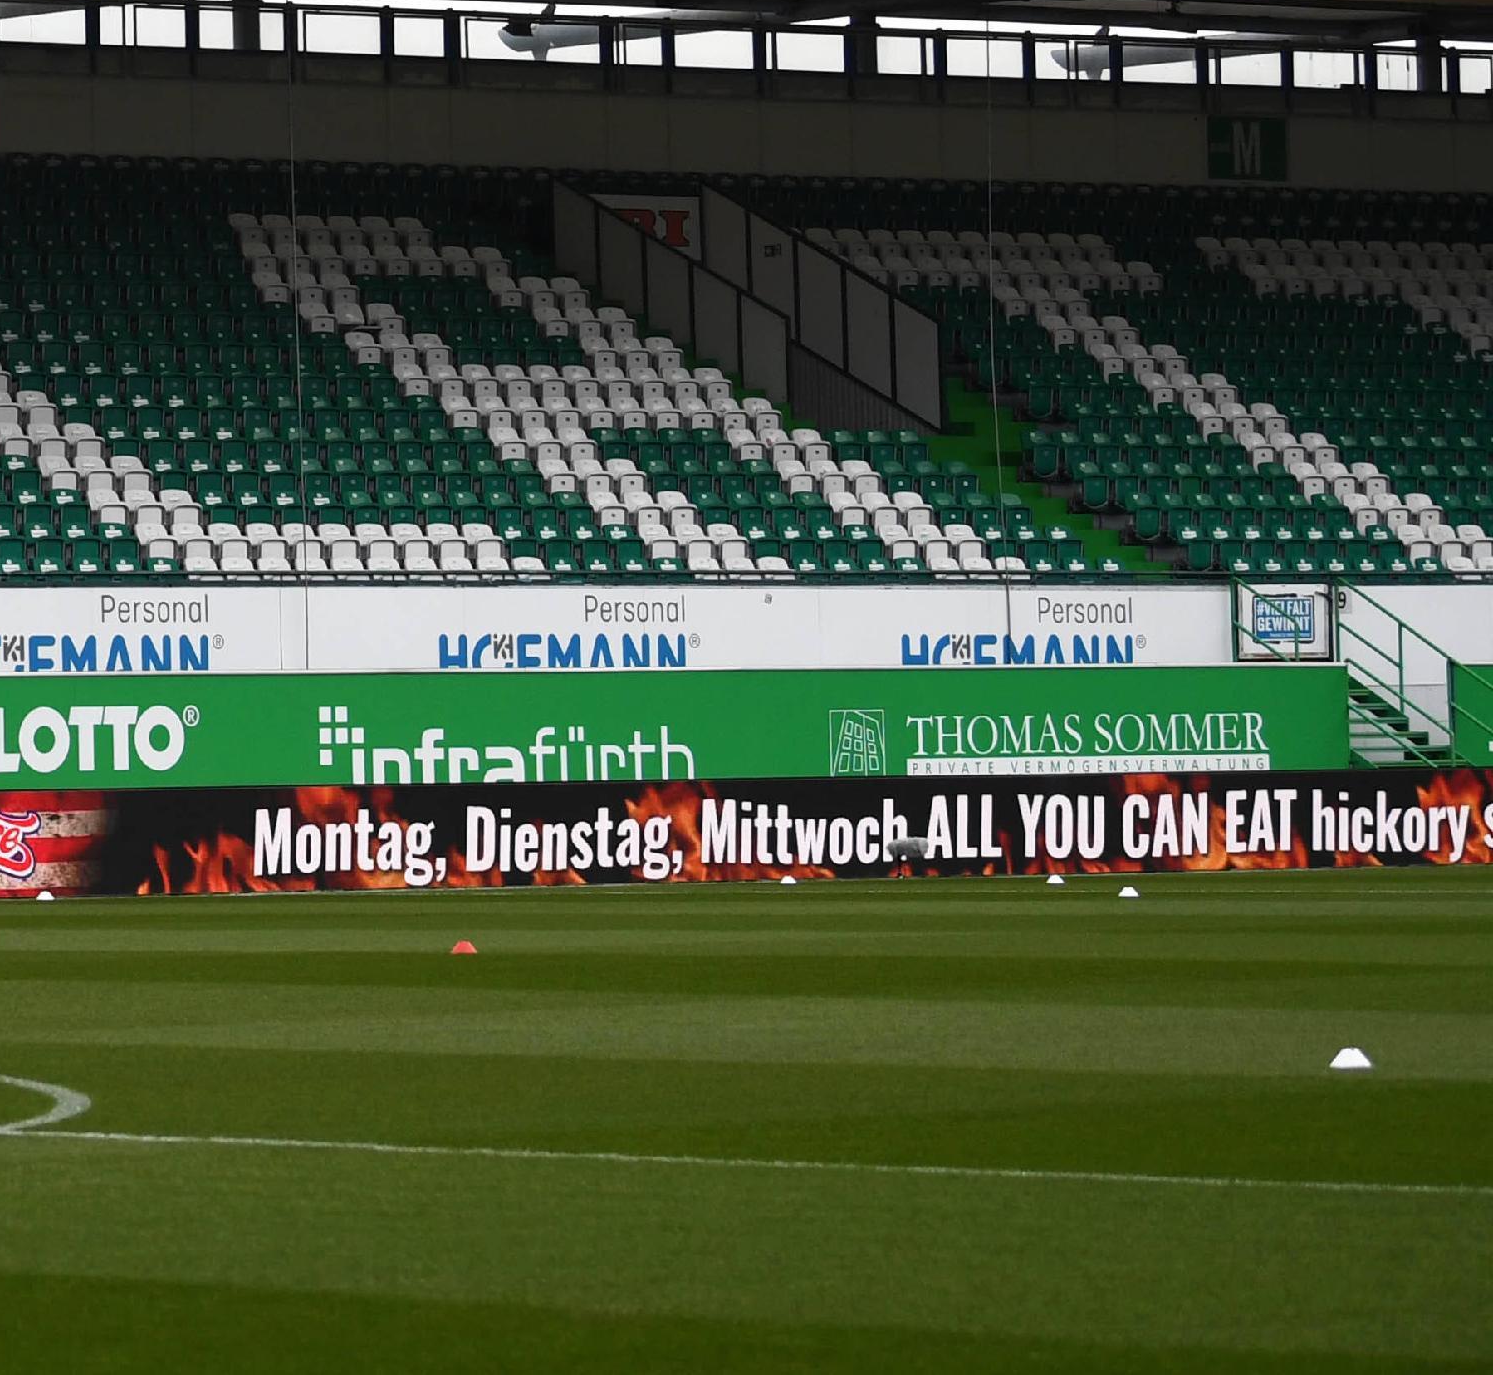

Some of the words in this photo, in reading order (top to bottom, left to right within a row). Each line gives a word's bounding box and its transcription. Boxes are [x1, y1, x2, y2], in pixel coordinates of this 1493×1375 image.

[1230, 120, 1263, 176] M
[99, 594, 210, 625] Personal
[584, 593, 687, 624] Personal
[1036, 596, 1134, 626] Personal
[1337, 591, 1347, 609] 9
[906, 713, 1084, 756] THOMAS
[1093, 712, 1270, 754] SOMMER
[912, 761, 995, 775] PRIVATE
[1011, 757, 1266, 775] VERMÖGENSVERWALTUNG
[251, 806, 447, 886] Montag,
[464, 804, 684, 881] Dienstag,
[699, 798, 909, 865] Mittwoch
[925, 793, 1003, 860] ALL
[1016, 793, 1106, 859] YOU
[1121, 792, 1210, 858] CAN
[1225, 788, 1299, 854] EAT
[1311, 787, 1471, 864] hickory
